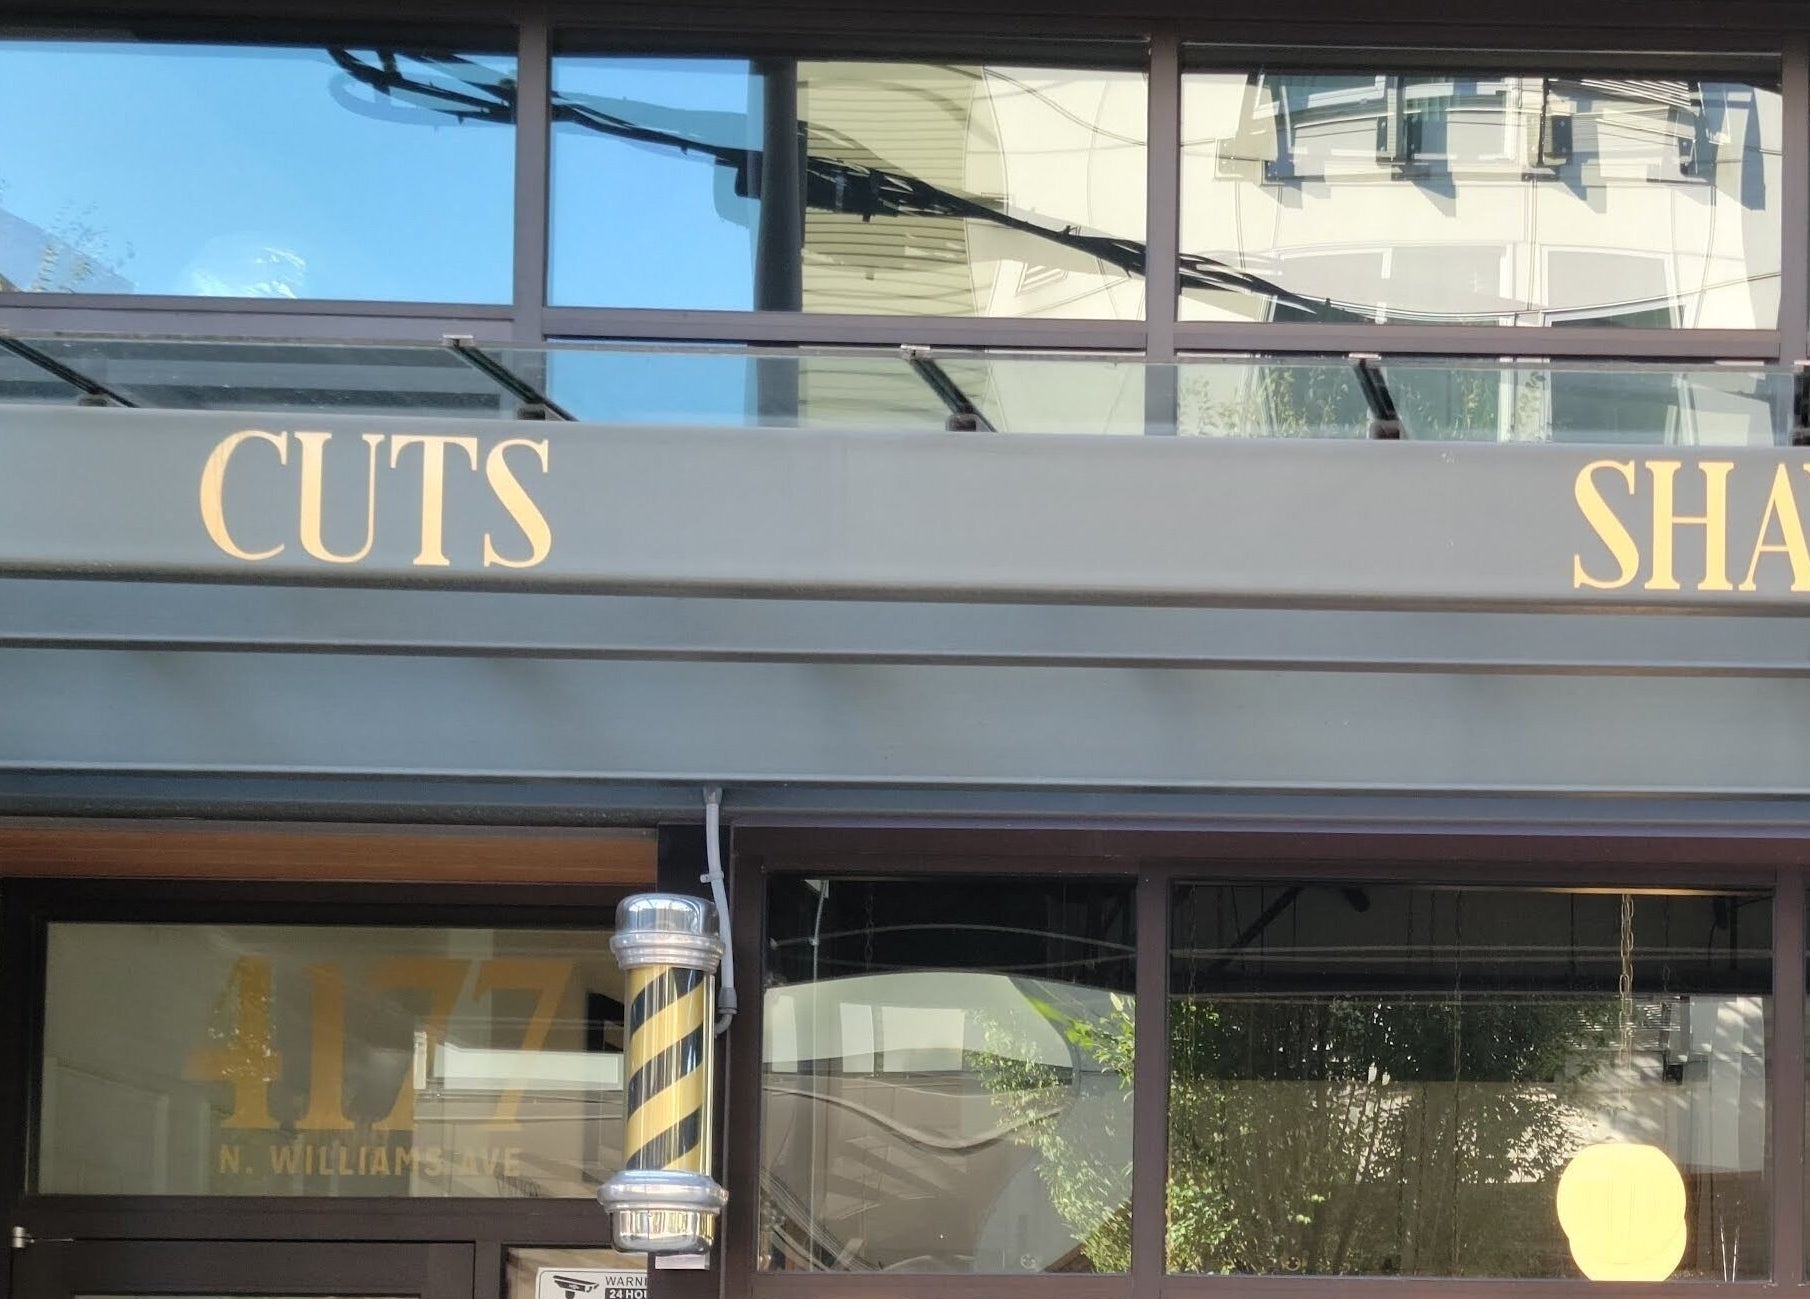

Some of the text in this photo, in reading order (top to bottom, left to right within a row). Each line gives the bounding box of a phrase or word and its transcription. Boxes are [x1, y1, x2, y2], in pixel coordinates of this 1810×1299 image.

[199, 430, 552, 568] CUTS
[182, 953, 573, 1133] 4177
[219, 1144, 523, 1177] N. WILLIAMS AVE
[609, 1289, 623, 1299] 24
